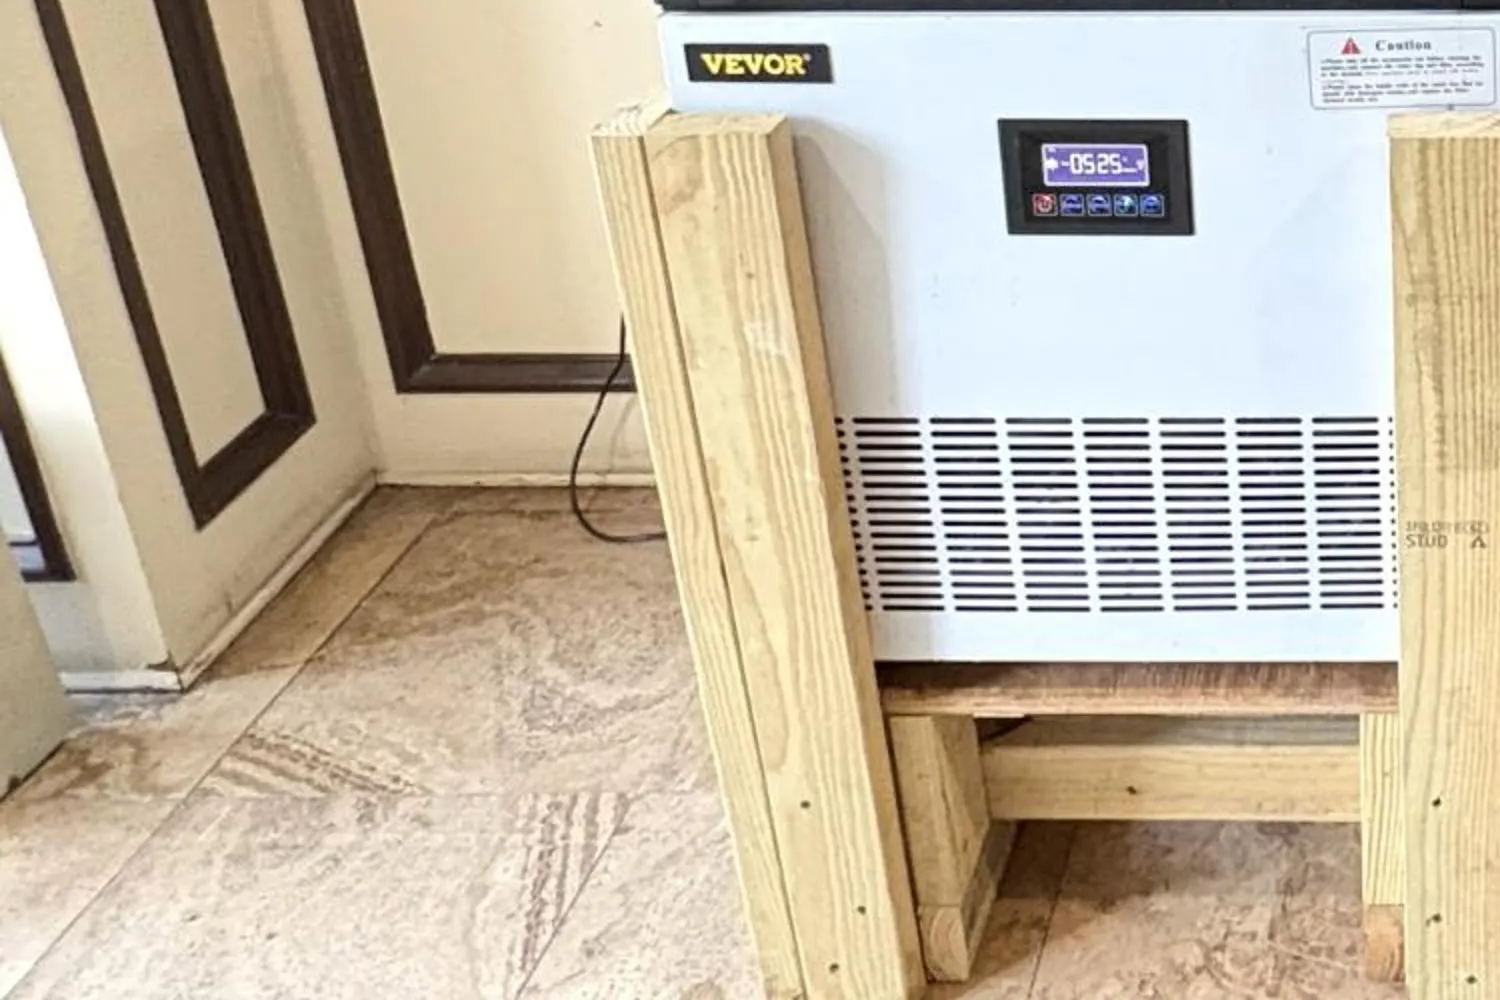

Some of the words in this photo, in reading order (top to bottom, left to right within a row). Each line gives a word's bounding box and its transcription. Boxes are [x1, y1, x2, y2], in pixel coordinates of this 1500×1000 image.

[1375, 39, 1432, 52] Caution
[700, 52, 807, 76] VEVOR
[1405, 533, 1449, 550] STUD
